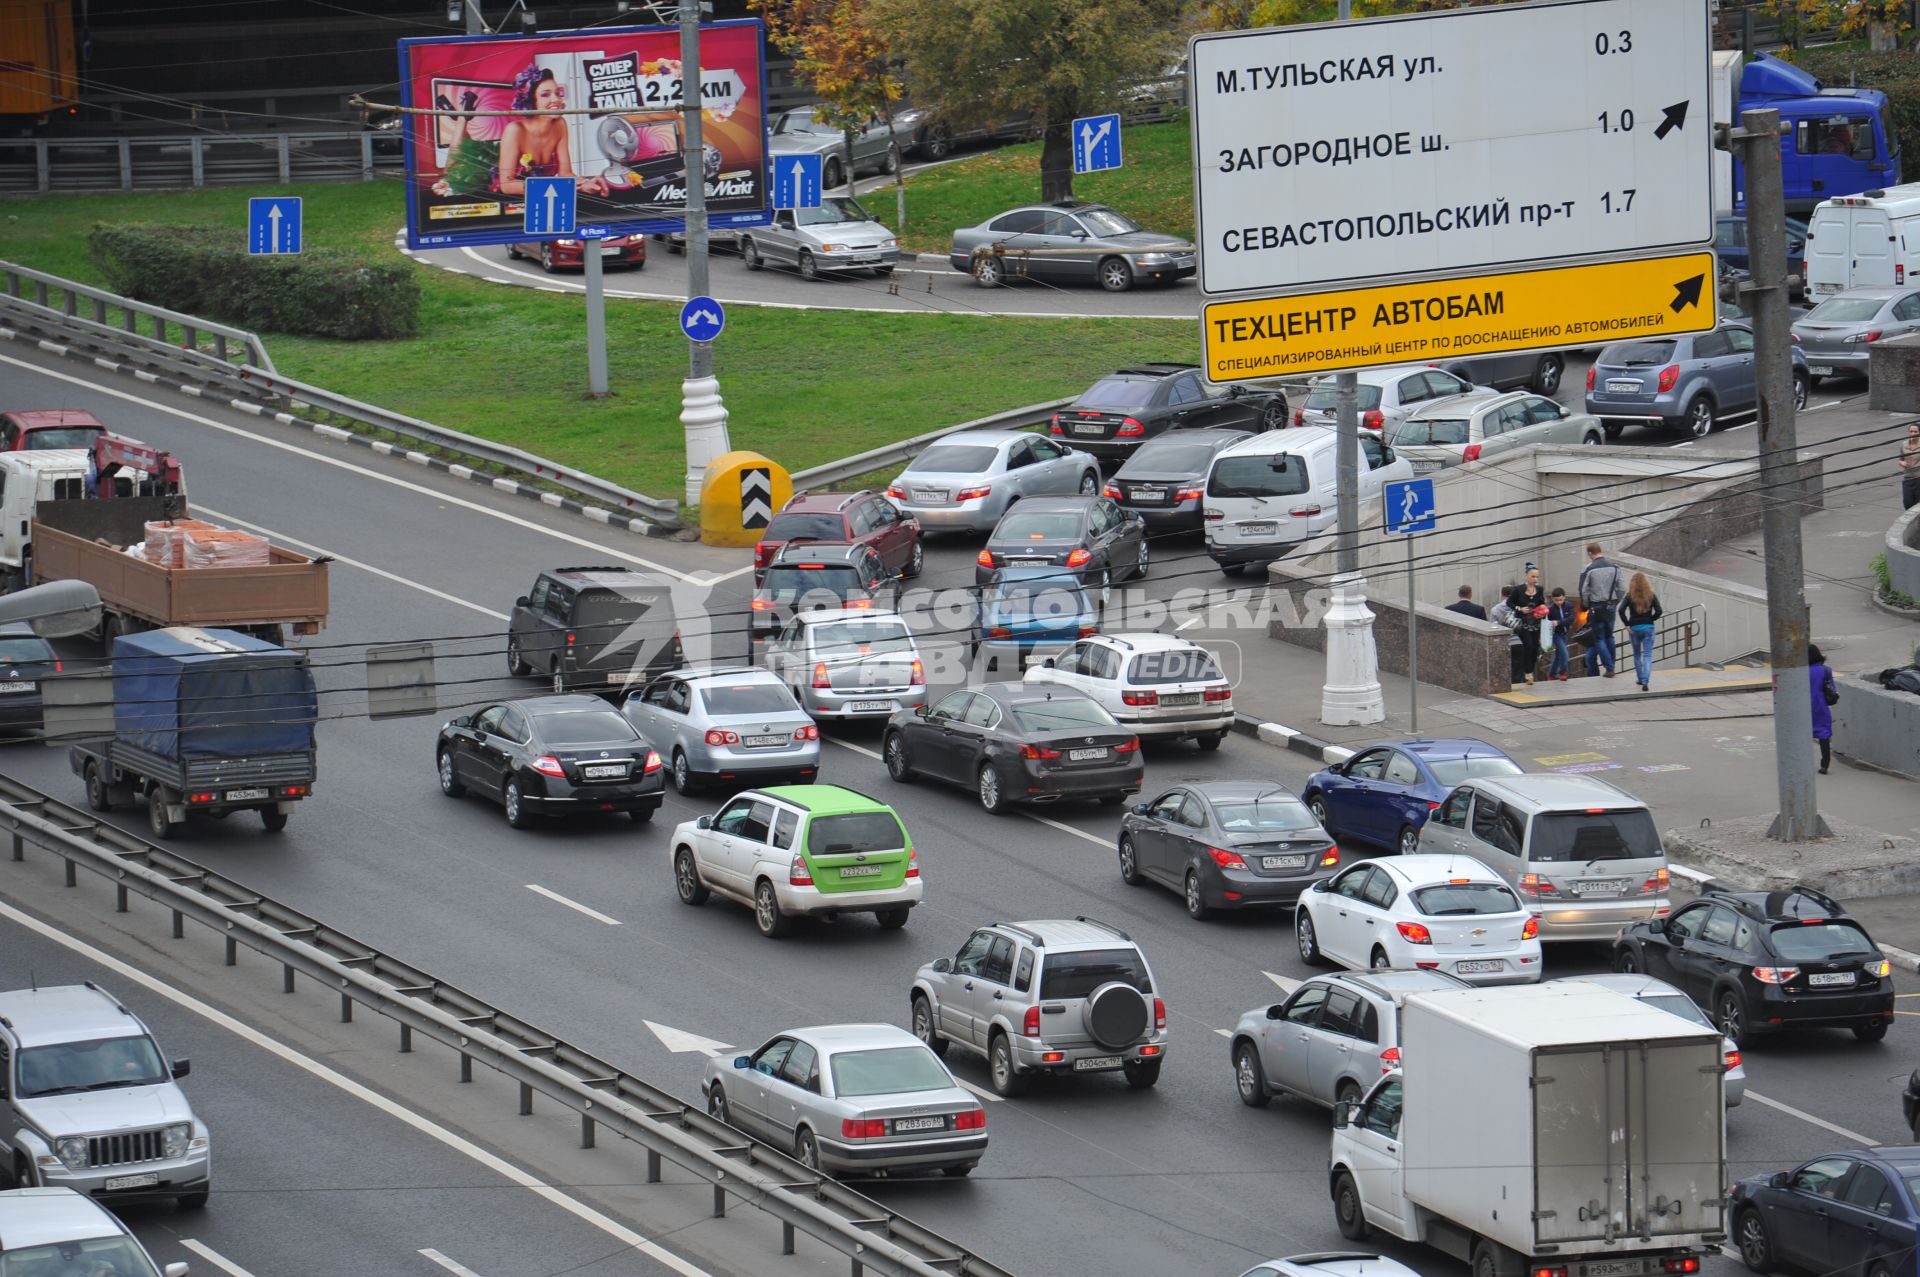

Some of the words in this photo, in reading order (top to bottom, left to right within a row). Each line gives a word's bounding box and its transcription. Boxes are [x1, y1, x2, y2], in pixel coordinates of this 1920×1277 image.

[1595, 30, 1633, 55] 0.3
[589, 59, 633, 78] СУПЕР
[1216, 54, 1393, 94] М.ТУЛЬСКАЯ
[1403, 57, 1443, 82] ул.
[591, 76, 635, 92] БРЕНДЫ
[594, 94, 639, 109] ТАМ!
[1598, 108, 1634, 133] 1.0
[1219, 131, 1411, 173] ЗАГОРОДНОЕ
[1421, 134, 1449, 153] ш.
[1600, 189, 1636, 213] 1.7
[1222, 197, 1510, 252] СЕВАСТОПОЛЬСКИЙ
[1520, 201, 1575, 226] пр-т
[1214, 307, 1356, 342] ТЕХЦЕНТР
[1372, 291, 1504, 327] АВТОБАМ
[1217, 342, 1382, 371] СПЕЦИАЛИЗИРОВАННЫЙ
[1385, 340, 1428, 356] ЦЕНТР
[1431, 336, 1450, 350] ПО
[1453, 325, 1561, 348] ДООСНАЩЕНИЮ
[1565, 312, 1665, 335] АВТОМОБИЛЕЙ
